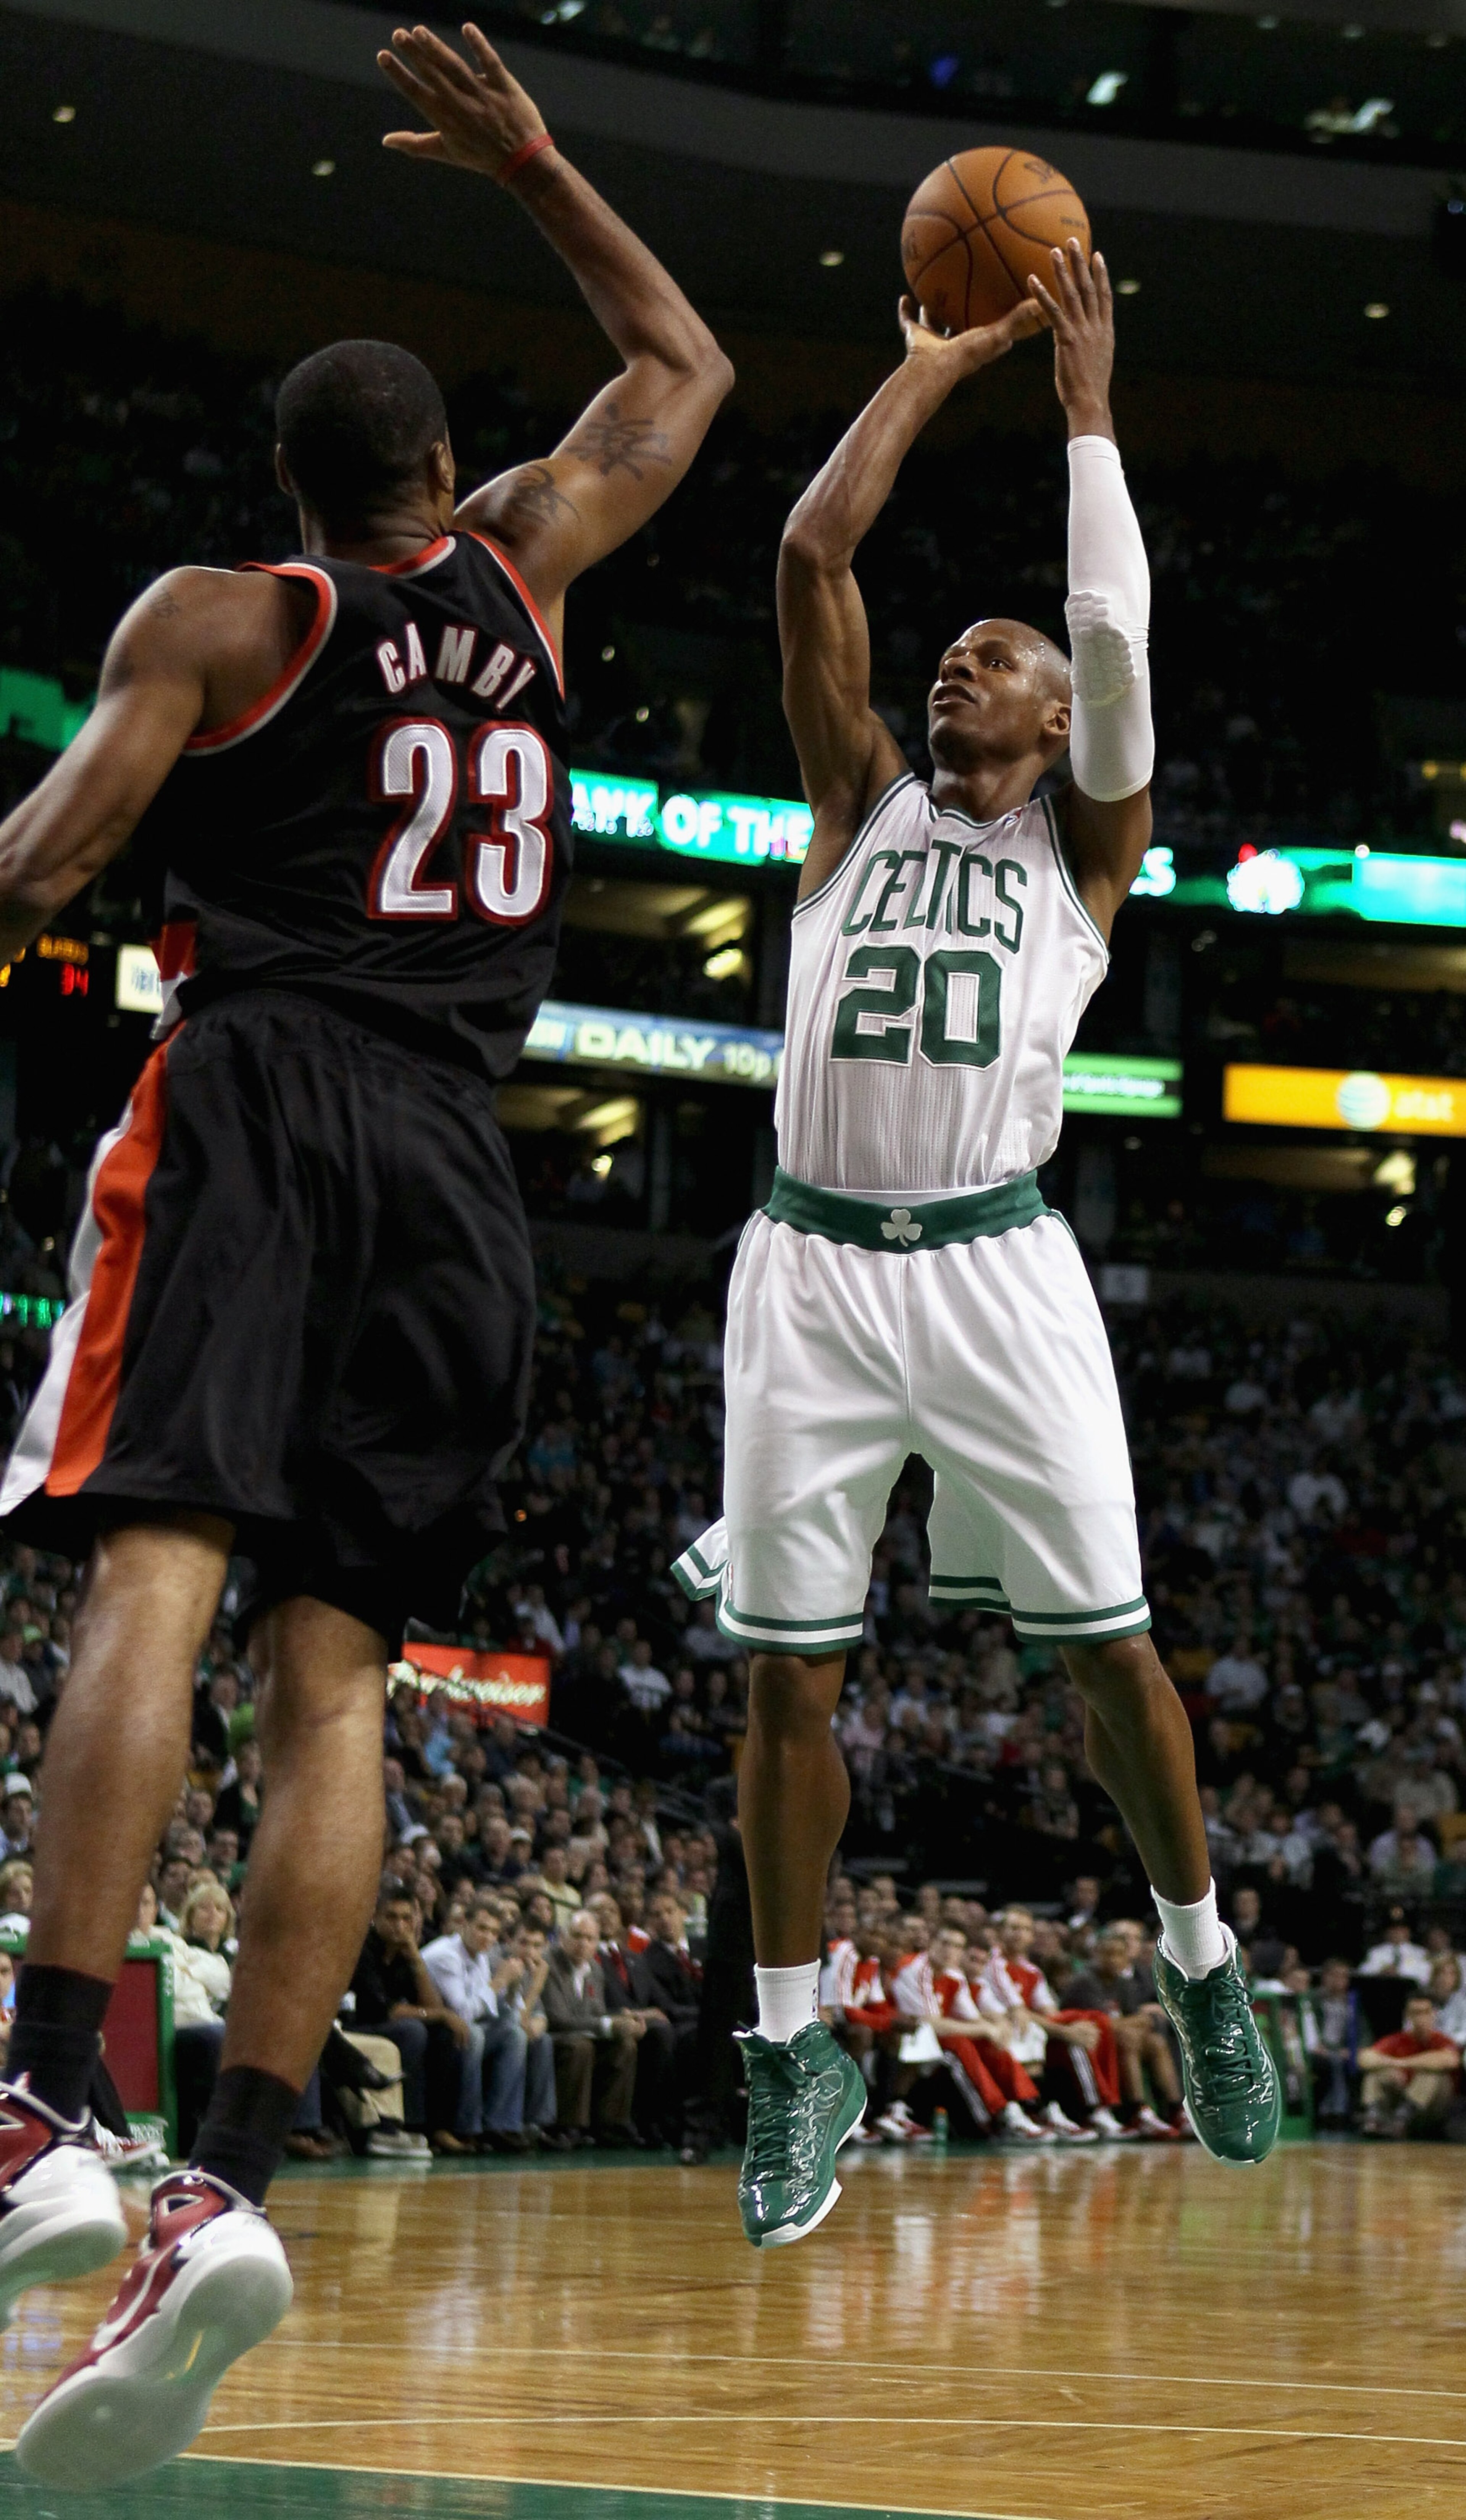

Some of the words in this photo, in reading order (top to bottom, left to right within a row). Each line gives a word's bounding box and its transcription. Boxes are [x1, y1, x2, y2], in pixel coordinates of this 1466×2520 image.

[377, 622, 536, 710] CAMBY
[368, 717, 554, 925] 23
[662, 794, 722, 848] OF
[726, 805, 814, 862] THE
[841, 839, 1028, 954] CELTICS
[576, 1021, 715, 1070] DAILY
[829, 942, 1006, 1071] 20
